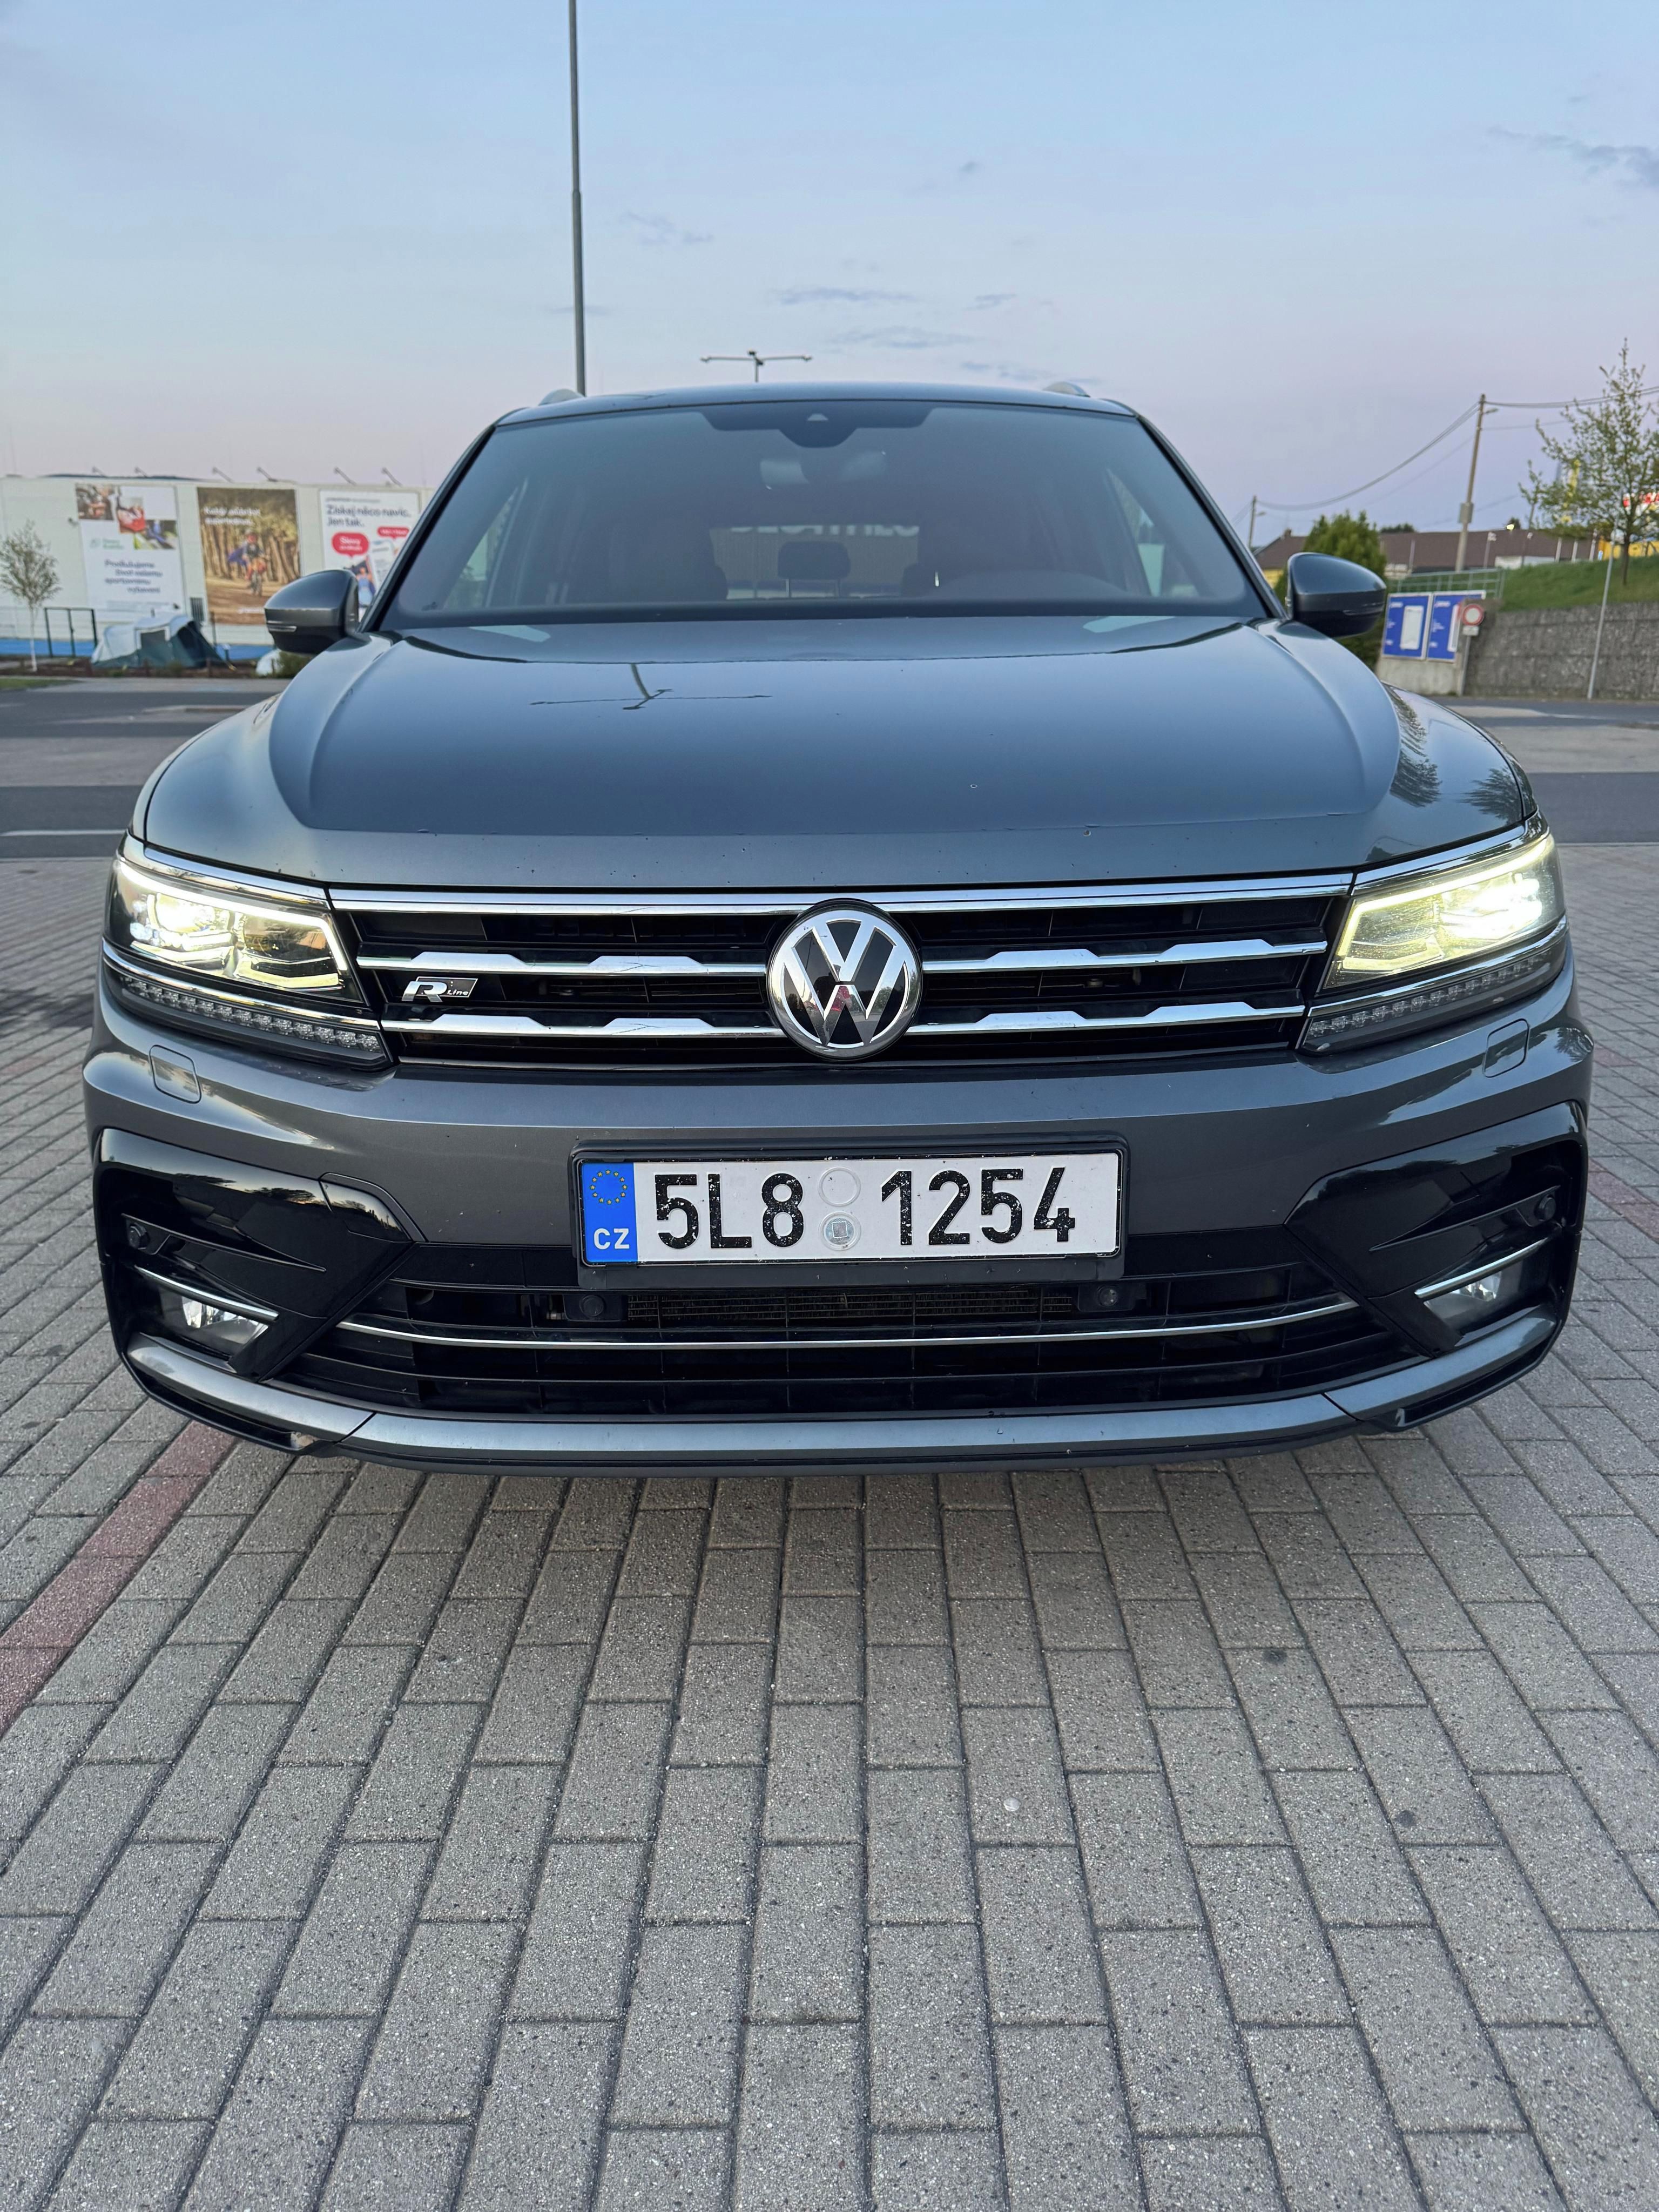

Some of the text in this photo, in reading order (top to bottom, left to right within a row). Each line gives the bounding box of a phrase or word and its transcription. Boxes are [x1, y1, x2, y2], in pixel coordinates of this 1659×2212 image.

[654, 1166, 1076, 1249] 5L8 1254
[593, 1228, 630, 1250] CZ
